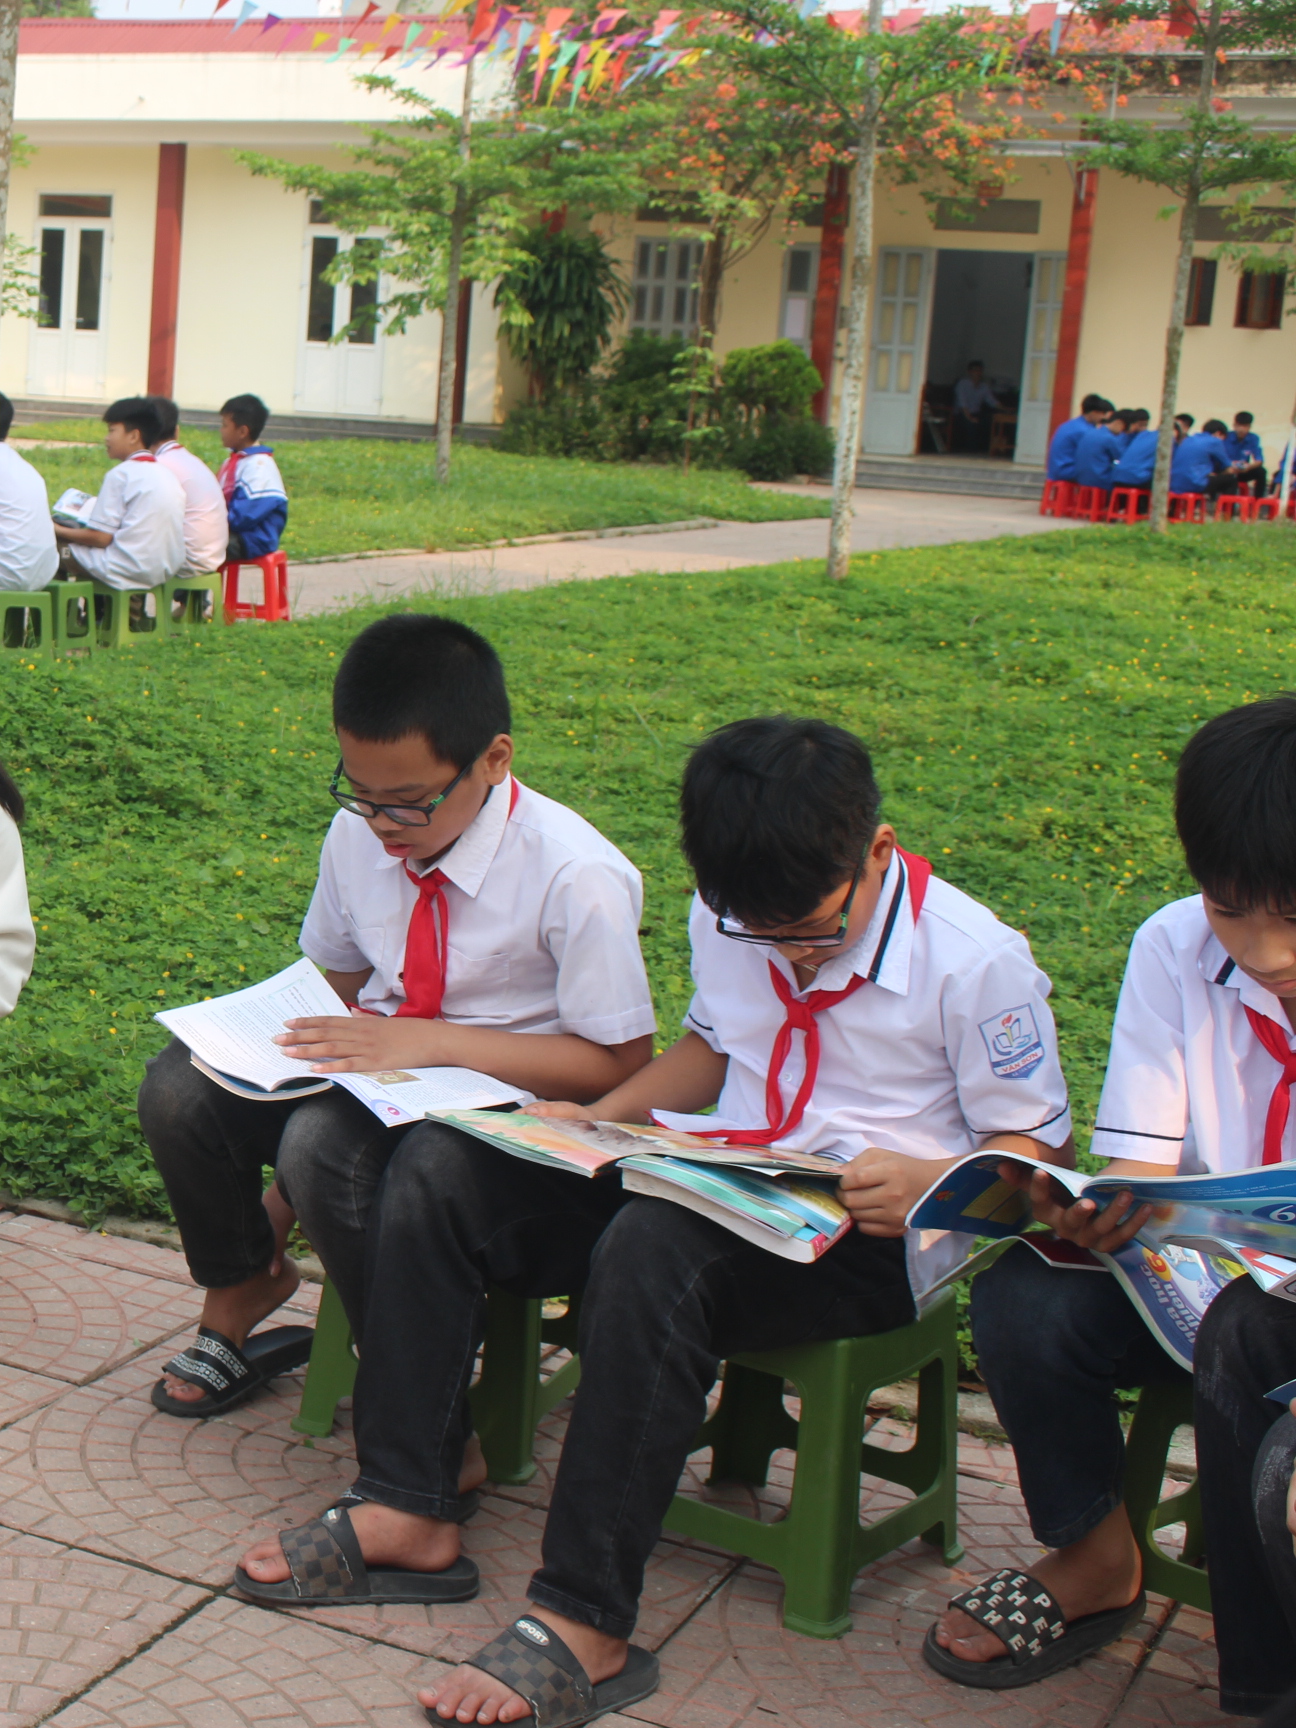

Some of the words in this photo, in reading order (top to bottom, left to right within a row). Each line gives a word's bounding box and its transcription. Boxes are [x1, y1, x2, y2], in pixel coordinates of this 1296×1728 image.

[1269, 1204, 1296, 1222] 6
[1164, 1283, 1201, 1332] hiên
[1166, 1307, 1196, 1344] hoa
[517, 1620, 550, 1643] SPORT
